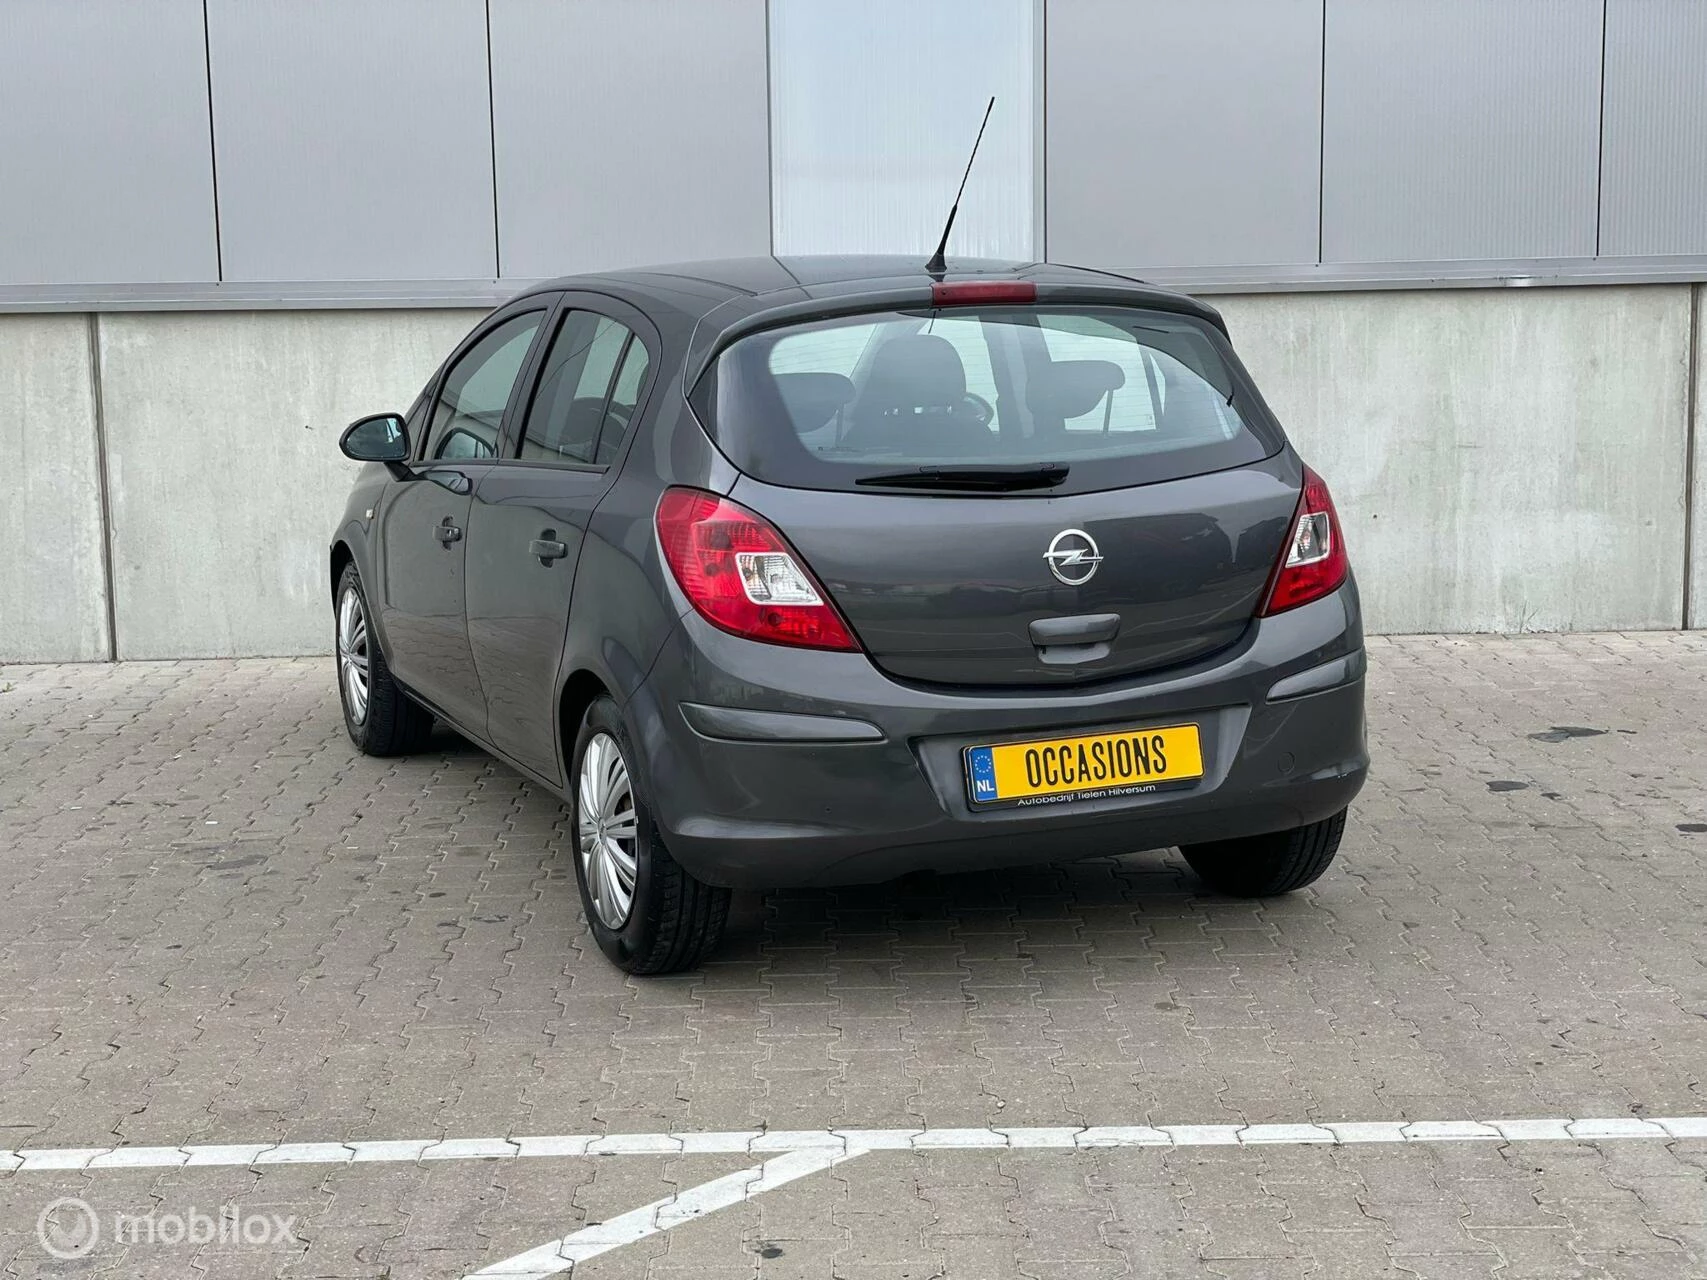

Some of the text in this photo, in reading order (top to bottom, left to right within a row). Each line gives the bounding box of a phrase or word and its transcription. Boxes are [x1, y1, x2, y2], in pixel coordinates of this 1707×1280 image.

[1025, 735, 1167, 788] OCCASIONS
[977, 779, 995, 793] NL
[1017, 784, 1156, 806] Autobedrijf Tielen Hilversum
